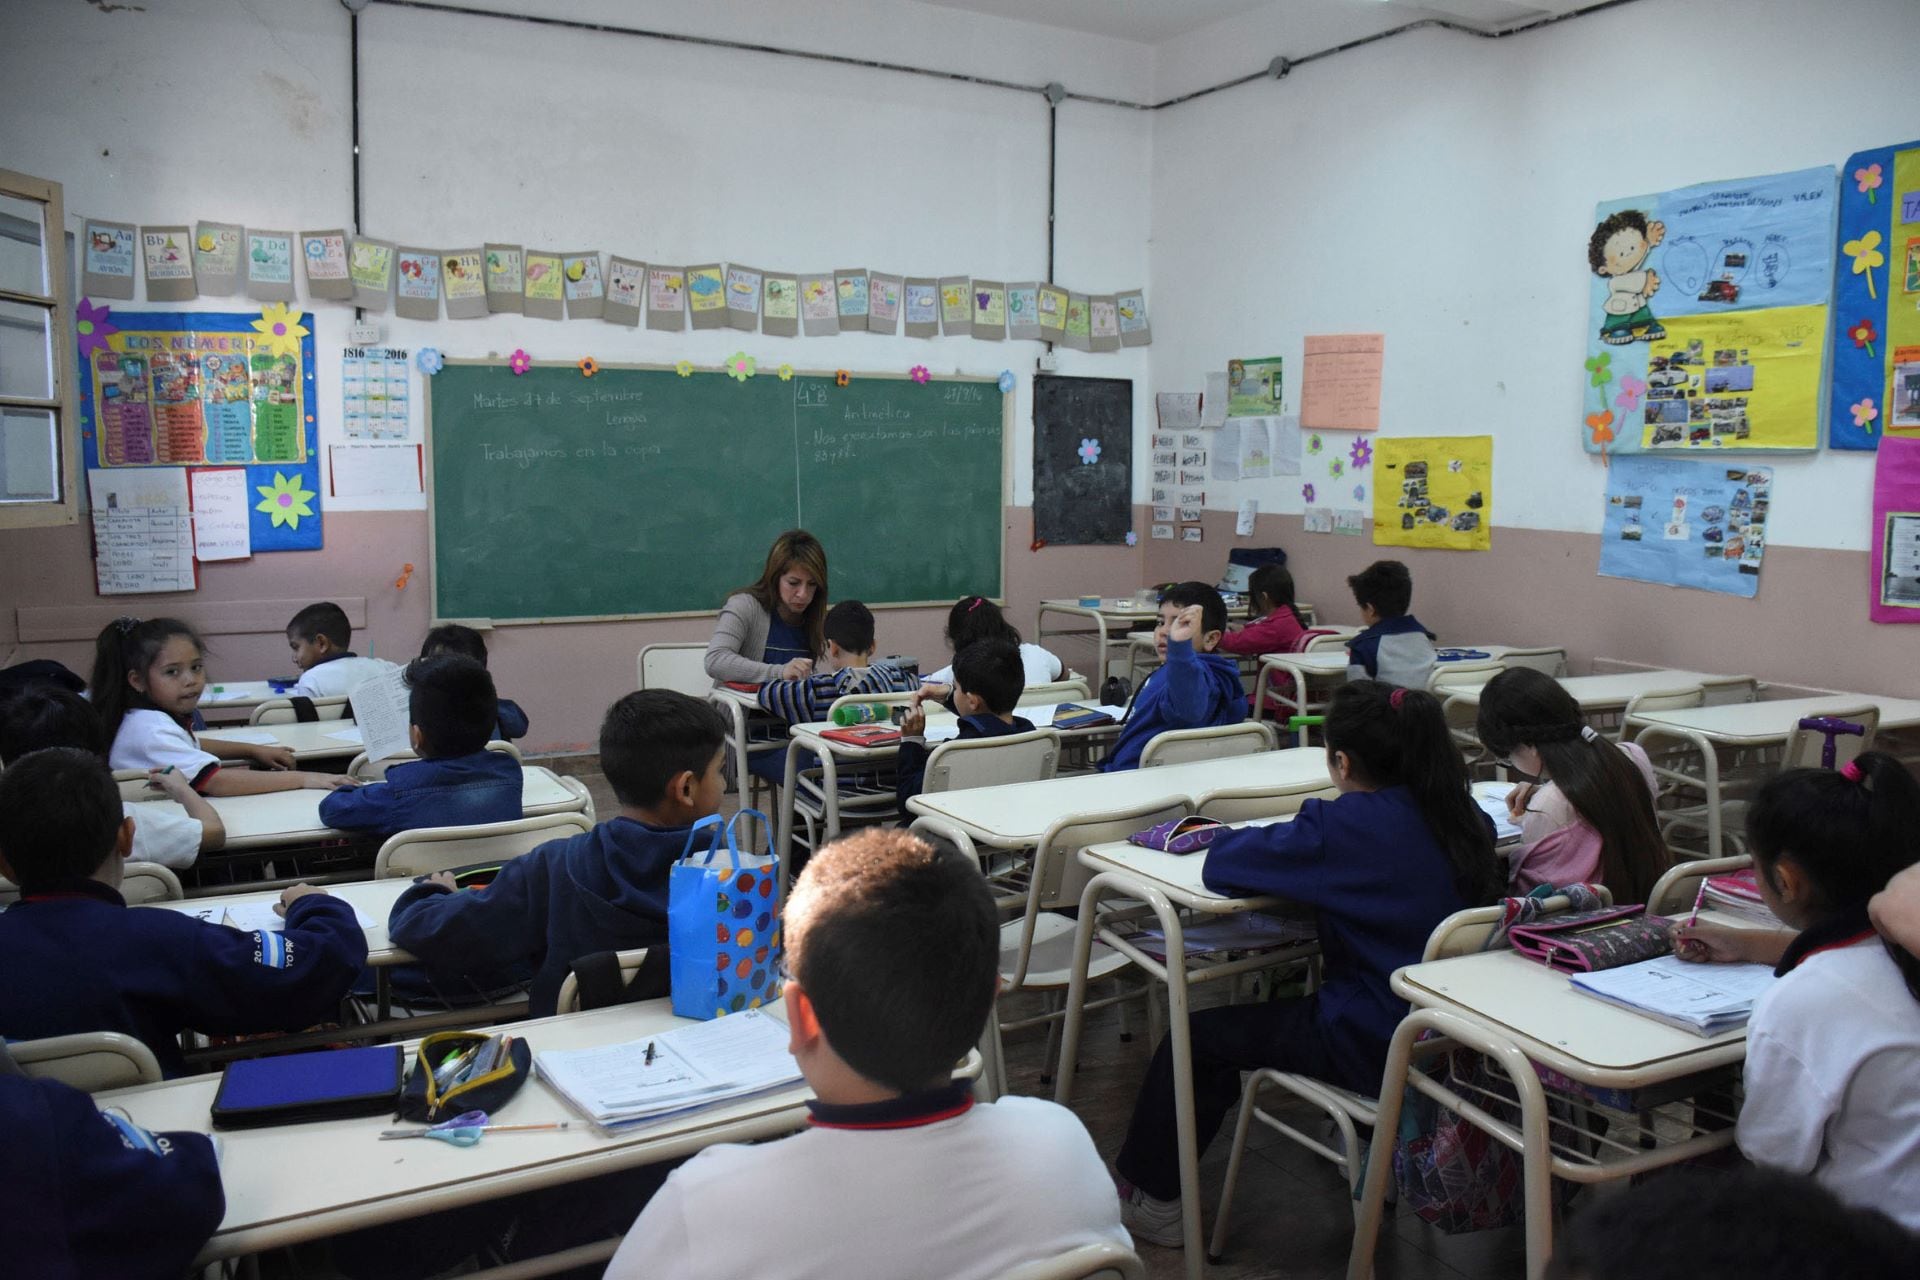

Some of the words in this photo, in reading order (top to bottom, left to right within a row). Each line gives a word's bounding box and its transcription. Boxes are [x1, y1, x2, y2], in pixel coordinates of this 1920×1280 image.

[146, 235, 165, 246] Bb
[268, 239, 286, 250] Dd
[128, 336, 163, 349] LOS
[343, 347, 365, 359] 1816
[384, 349, 408, 360] 2016
[473, 392, 518, 409] Martes
[545, 391, 562, 405] de
[606, 410, 648, 431] Lengua
[814, 427, 836, 447] Nos
[917, 428, 937, 439] con
[942, 420, 961, 437] las
[478, 443, 568, 469] Trabajamos
[575, 447, 595, 457] en
[602, 440, 617, 457] la
[254, 951, 262, 963] 20
[286, 954, 294, 967] YO
